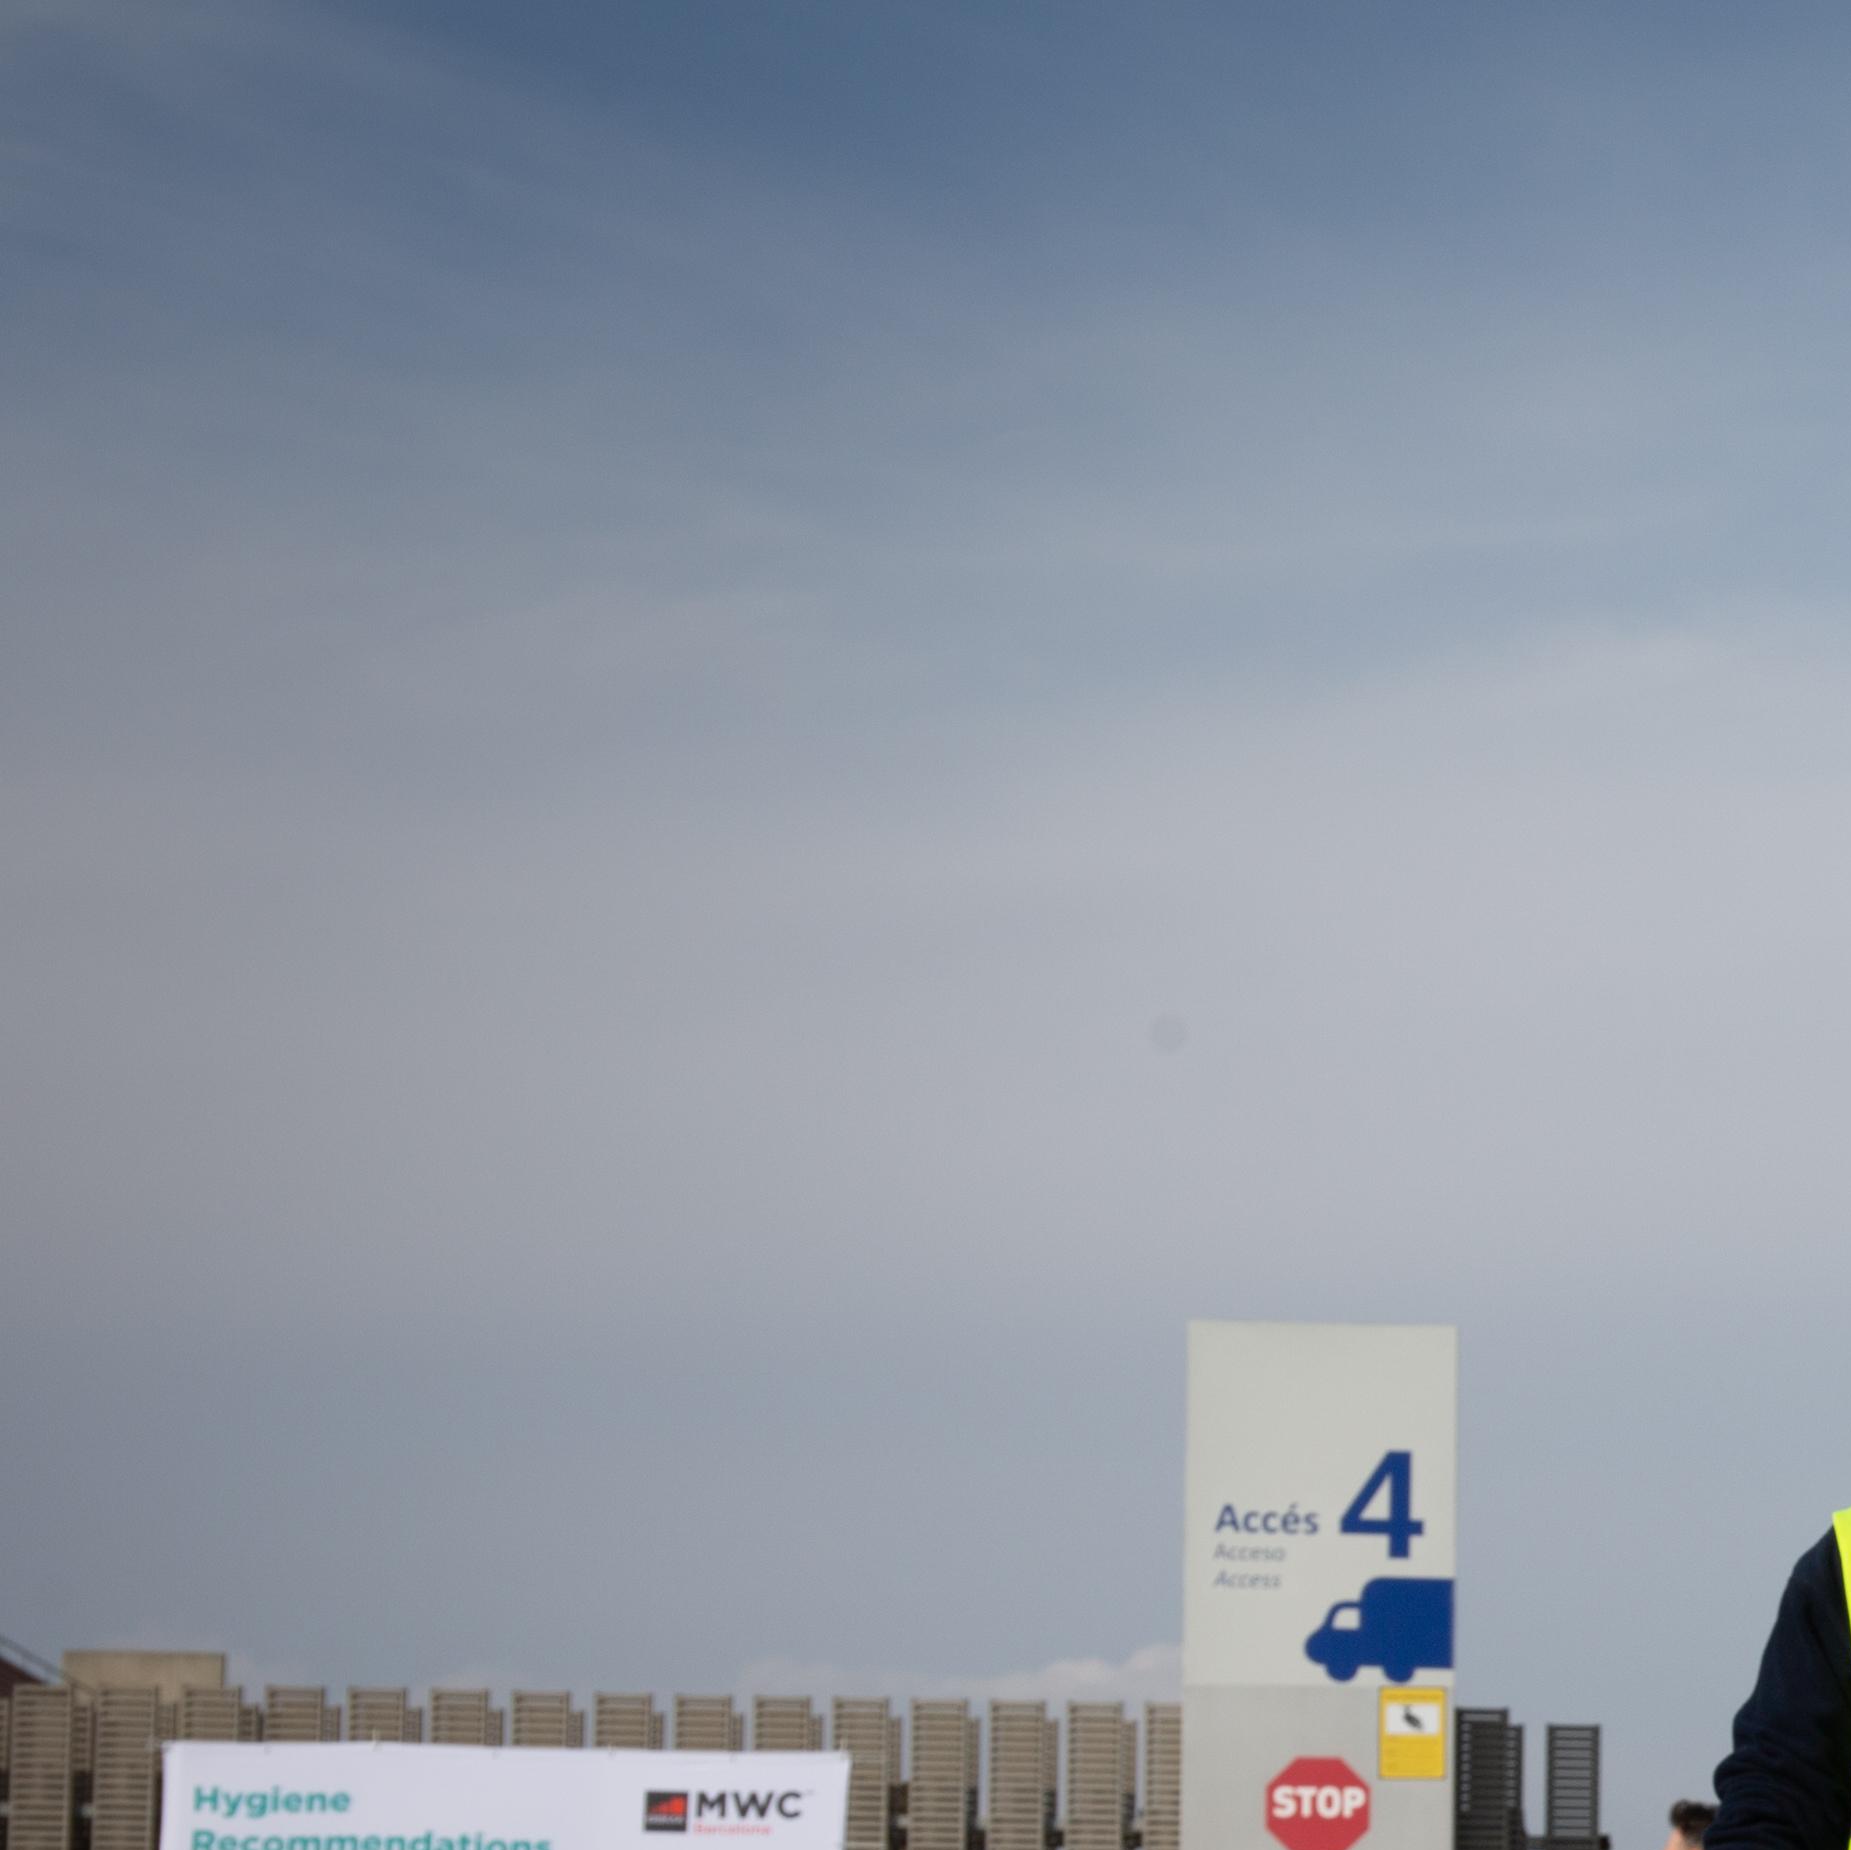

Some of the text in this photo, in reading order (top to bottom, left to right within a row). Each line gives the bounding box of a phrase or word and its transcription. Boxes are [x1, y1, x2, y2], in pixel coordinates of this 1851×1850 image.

[1214, 1450, 1424, 1559] Accés 4
[192, 1786, 352, 1818] Hygiene
[696, 1790, 803, 1819] MWC
[1271, 1785, 1367, 1820] STOP
